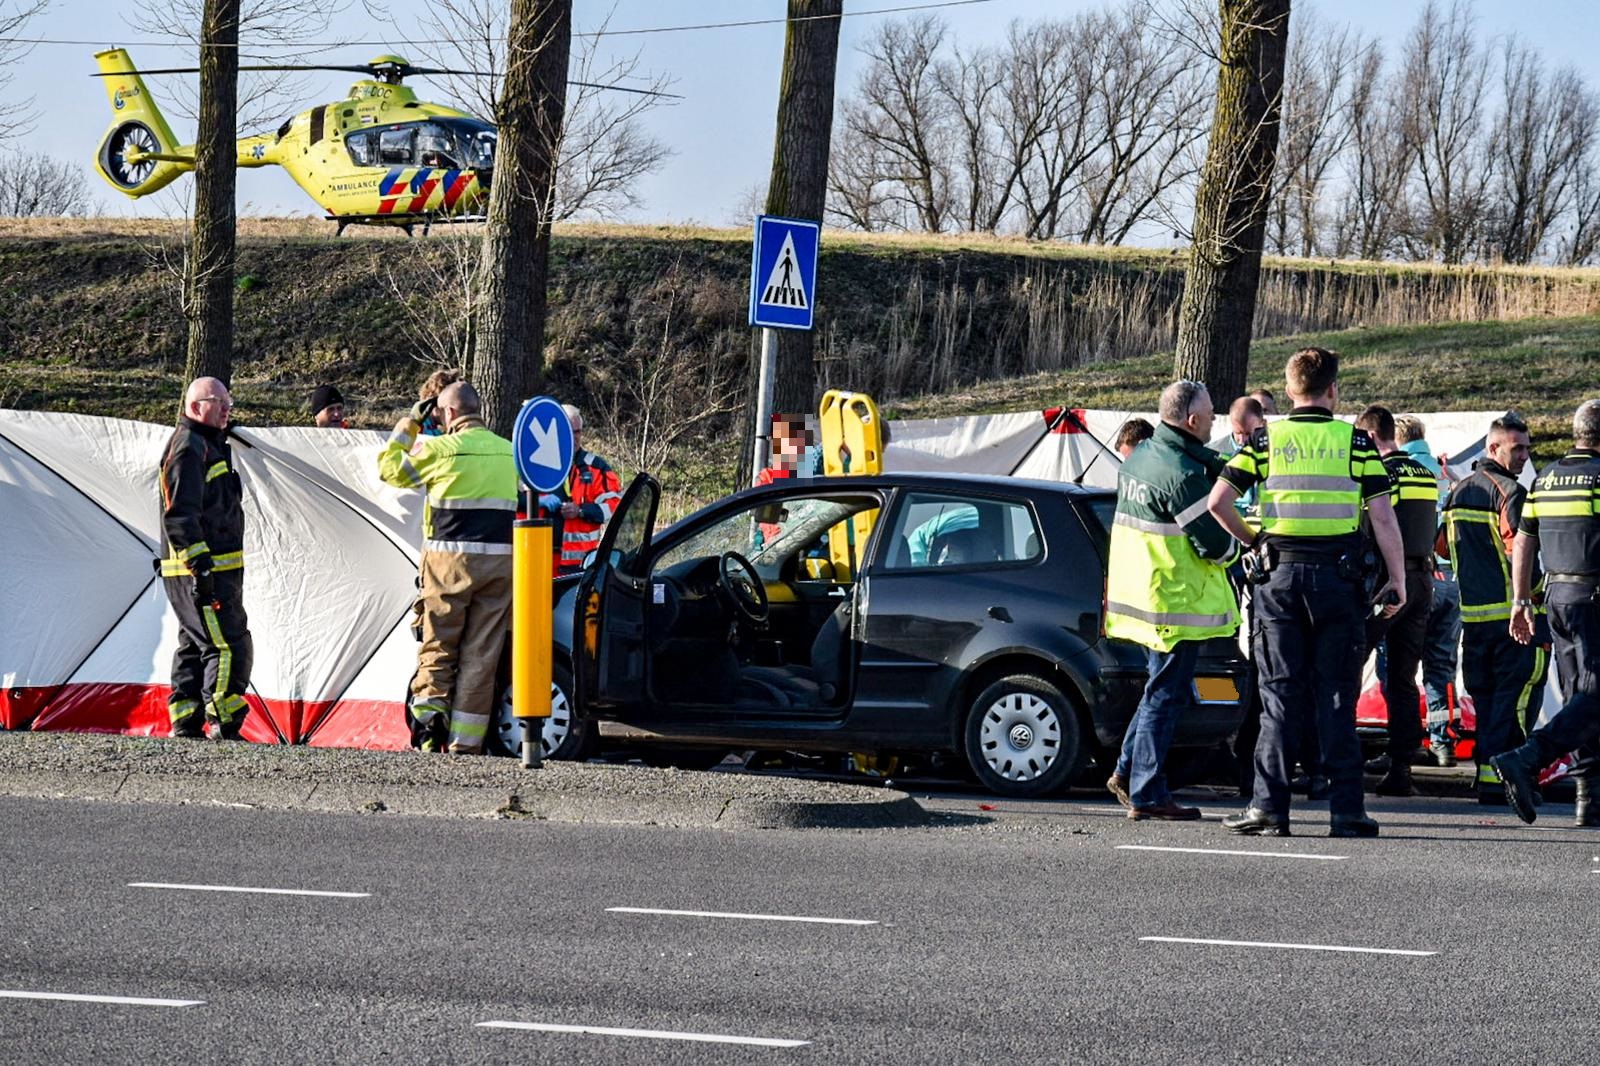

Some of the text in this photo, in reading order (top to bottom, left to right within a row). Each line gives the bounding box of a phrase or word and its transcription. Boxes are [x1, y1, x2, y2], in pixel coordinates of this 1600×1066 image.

[332, 180, 377, 191] AMBULANCE
[1273, 440, 1346, 463] POLITIE
[1539, 470, 1584, 490] POLITIE
